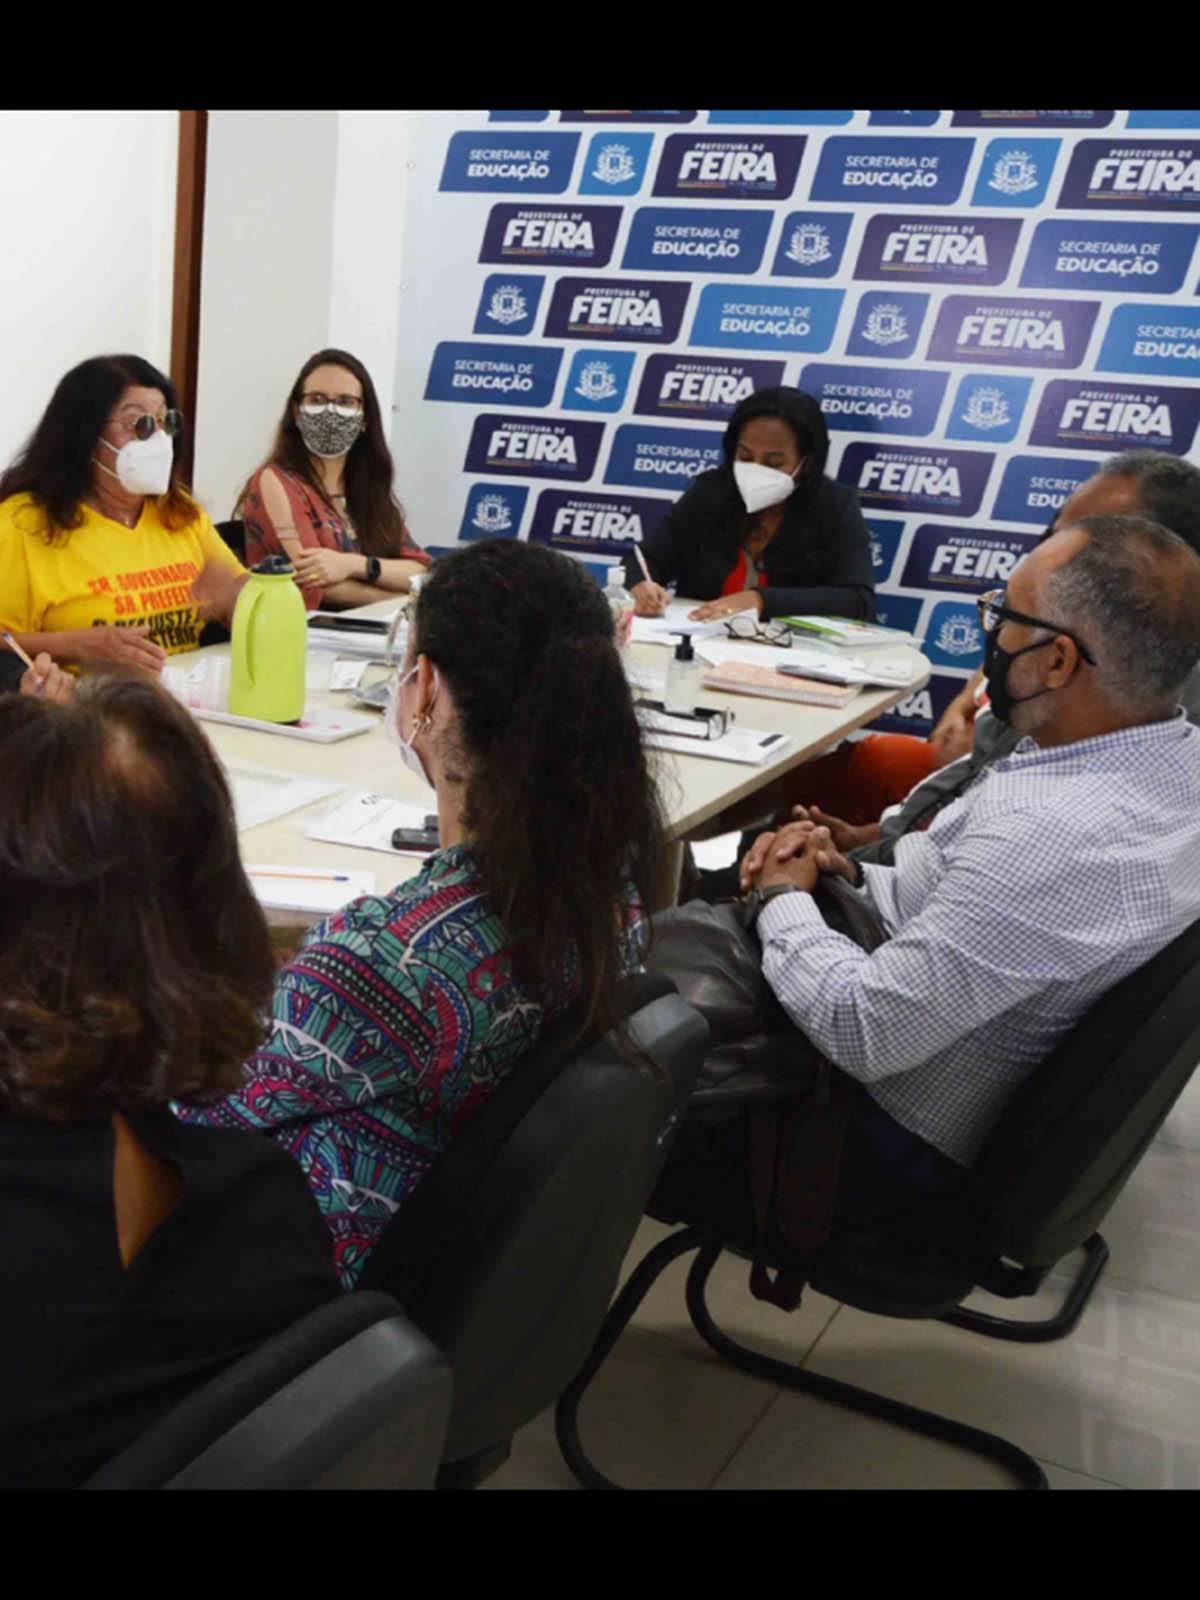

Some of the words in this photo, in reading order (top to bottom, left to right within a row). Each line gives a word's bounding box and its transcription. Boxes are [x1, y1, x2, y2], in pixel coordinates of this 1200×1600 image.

[469, 149, 534, 161] SECRETARIA
[537, 150, 551, 161] DE
[845, 155, 916, 169] SECRETARIA
[919, 157, 938, 169] DE
[467, 163, 549, 181] EDUCAÇÃO
[678, 150, 777, 181] FEIRA
[1088, 158, 1200, 192] FEIRA
[842, 170, 938, 189] EDUCAÇÃO
[502, 219, 594, 249] FEIRA
[654, 226, 720, 239] SECRETARIA
[723, 229, 740, 239] DE
[652, 241, 740, 260] EDUCAÇÃO
[881, 233, 988, 266] FEIRA
[1059, 241, 1136, 254] SECRETARIA
[1139, 242, 1161, 255] DE
[1055, 256, 1159, 276] EDUCAÇÃO
[568, 296, 662, 328] FEIRA
[721, 303, 791, 316] SECRETARIA
[793, 306, 811, 318] DE
[720, 317, 811, 339] EDUCAÇÃO
[956, 316, 1065, 351] FEIRA
[1133, 341, 1200, 359] EDUCA
[454, 360, 515, 373] SECRETARIA
[518, 364, 533, 375] DE
[452, 374, 533, 393] EDUCAÇÃO
[660, 371, 755, 404] FEIRA
[822, 383, 892, 398] SECRETARIA
[896, 388, 913, 399] DE
[820, 399, 912, 420] EDUCAÇÃO
[1059, 399, 1172, 436] FEIRA
[487, 431, 577, 464] FEIRA
[635, 443, 701, 459] SECRETARIA
[703, 450, 720, 460] DE
[858, 460, 961, 496] FEIRA
[552, 508, 643, 542] FEIRA
